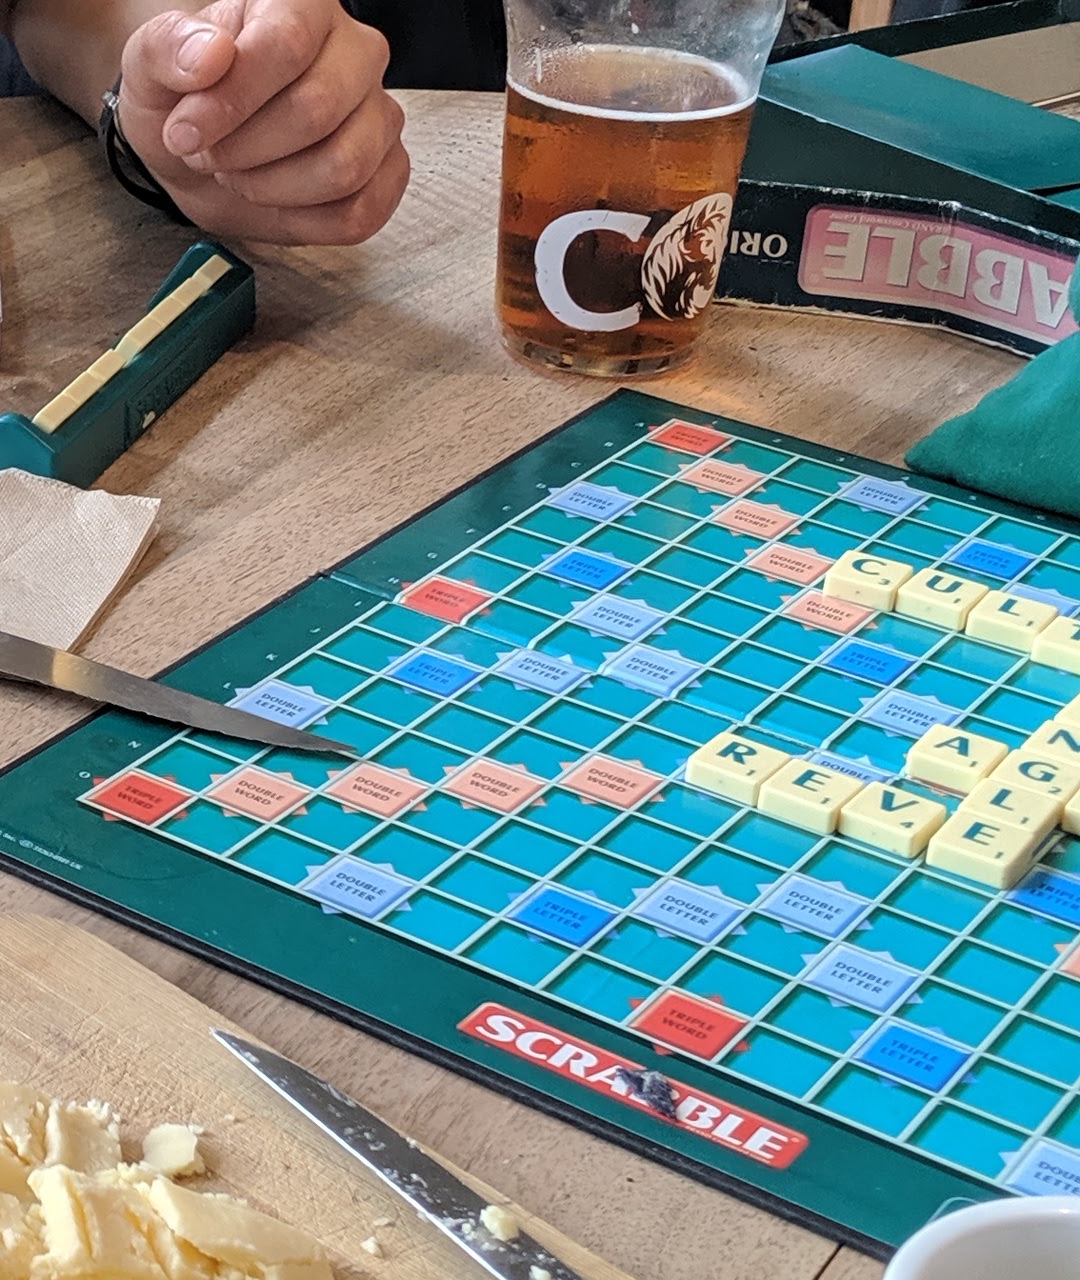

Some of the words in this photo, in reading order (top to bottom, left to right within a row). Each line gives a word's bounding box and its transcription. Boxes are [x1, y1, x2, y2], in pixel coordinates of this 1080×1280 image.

[700, 472, 736, 487] WORD
[702, 466, 745, 484] DOUBLE
[568, 496, 607, 512] LETTER
[573, 491, 615, 508] DOUBLE
[859, 490, 899, 506] LETTER
[863, 485, 906, 502] DOUBLE
[733, 514, 770, 530] WORD
[734, 508, 778, 526] DOUBLE
[768, 558, 806, 575] WORD
[770, 552, 815, 571] DOUBLE
[597, 605, 643, 626] DOUBLE
[805, 605, 844, 623] WORD
[807, 599, 855, 619] DOUBLE
[592, 610, 636, 630] LETTER
[517, 662, 562, 682] LETTER
[523, 656, 569, 678] DOUBLE
[625, 662, 670, 682] LETTER
[630, 656, 678, 677] DOUBLE
[255, 698, 296, 719] LETTER
[261, 691, 307, 714] DOUBLE
[888, 702, 939, 723] DOUBLE
[884, 709, 932, 729] LETTER
[588, 767, 639, 791] DOUBLE
[820, 758, 872, 784] DOUBLE
[237, 779, 286, 802] DOUBLE
[351, 783, 391, 803] WORD
[354, 776, 404, 799] DOUBLE
[469, 779, 510, 800] WORD
[472, 771, 521, 795] DOUBLE
[586, 775, 628, 795] WORD
[116, 791, 156, 811] WORD
[124, 785, 164, 805] TRIPLE
[233, 787, 273, 807] WORD
[329, 879, 377, 904] LETTER
[335, 870, 387, 897] DOUBLE
[542, 899, 590, 923] TRIPLE
[663, 893, 721, 921] DOUBLE
[783, 897, 837, 923] LETTER
[787, 889, 846, 916] DOUBLE
[531, 906, 585, 931] LETTER
[658, 901, 711, 928] LETTER
[829, 969, 884, 995] LETTER
[833, 961, 894, 988] DOUBLE
[661, 1015, 710, 1042] WORD
[667, 1008, 717, 1034] TRIPLE
[880, 1046, 936, 1073] LETTER
[891, 1039, 941, 1064] TRIPLE
[475, 1013, 788, 1160] SCRABLE
[1038, 1160, 1080, 1185] DOUB
[1033, 1171, 1080, 1196] LETTE
